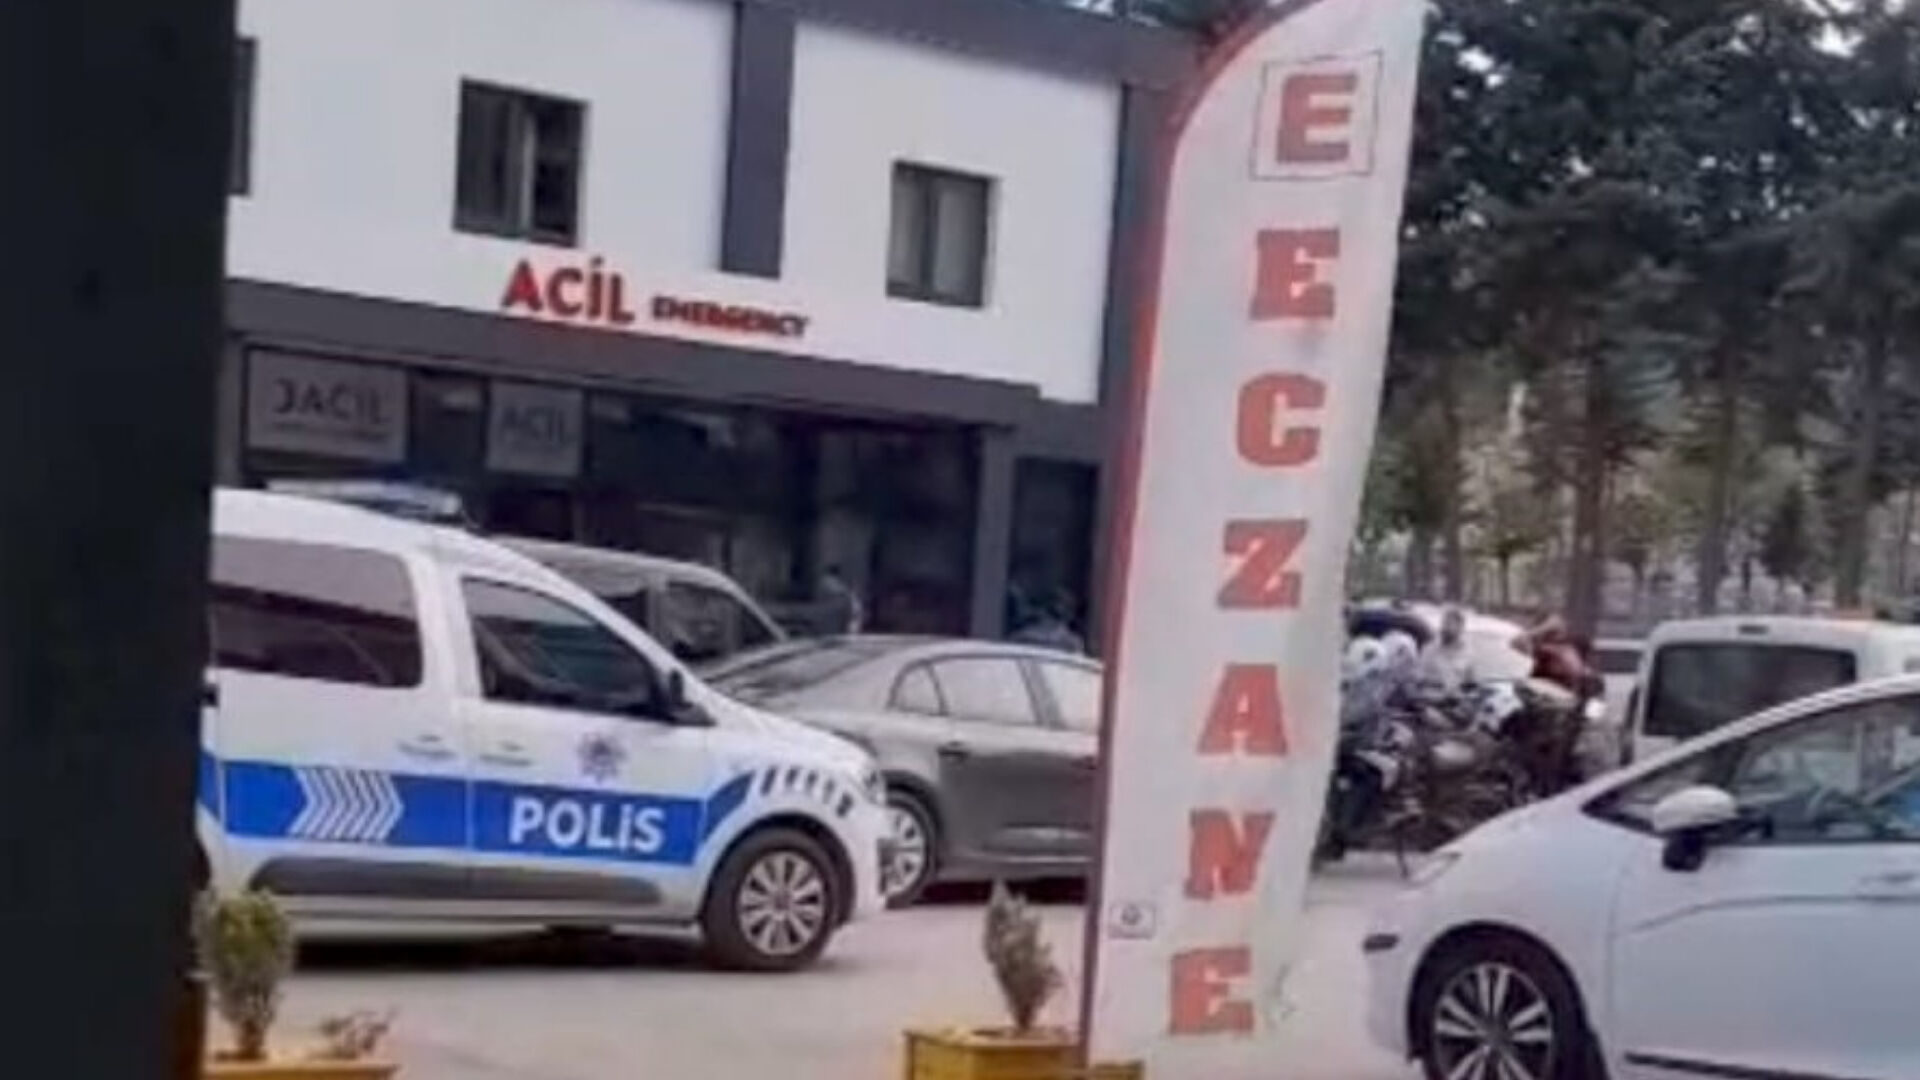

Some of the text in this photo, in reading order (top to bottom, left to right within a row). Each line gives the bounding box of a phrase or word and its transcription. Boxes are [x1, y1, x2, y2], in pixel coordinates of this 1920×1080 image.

[1276, 73, 1358, 164] E
[502, 257, 636, 325] ACİL
[1168, 228, 1340, 1037] ECZANE
